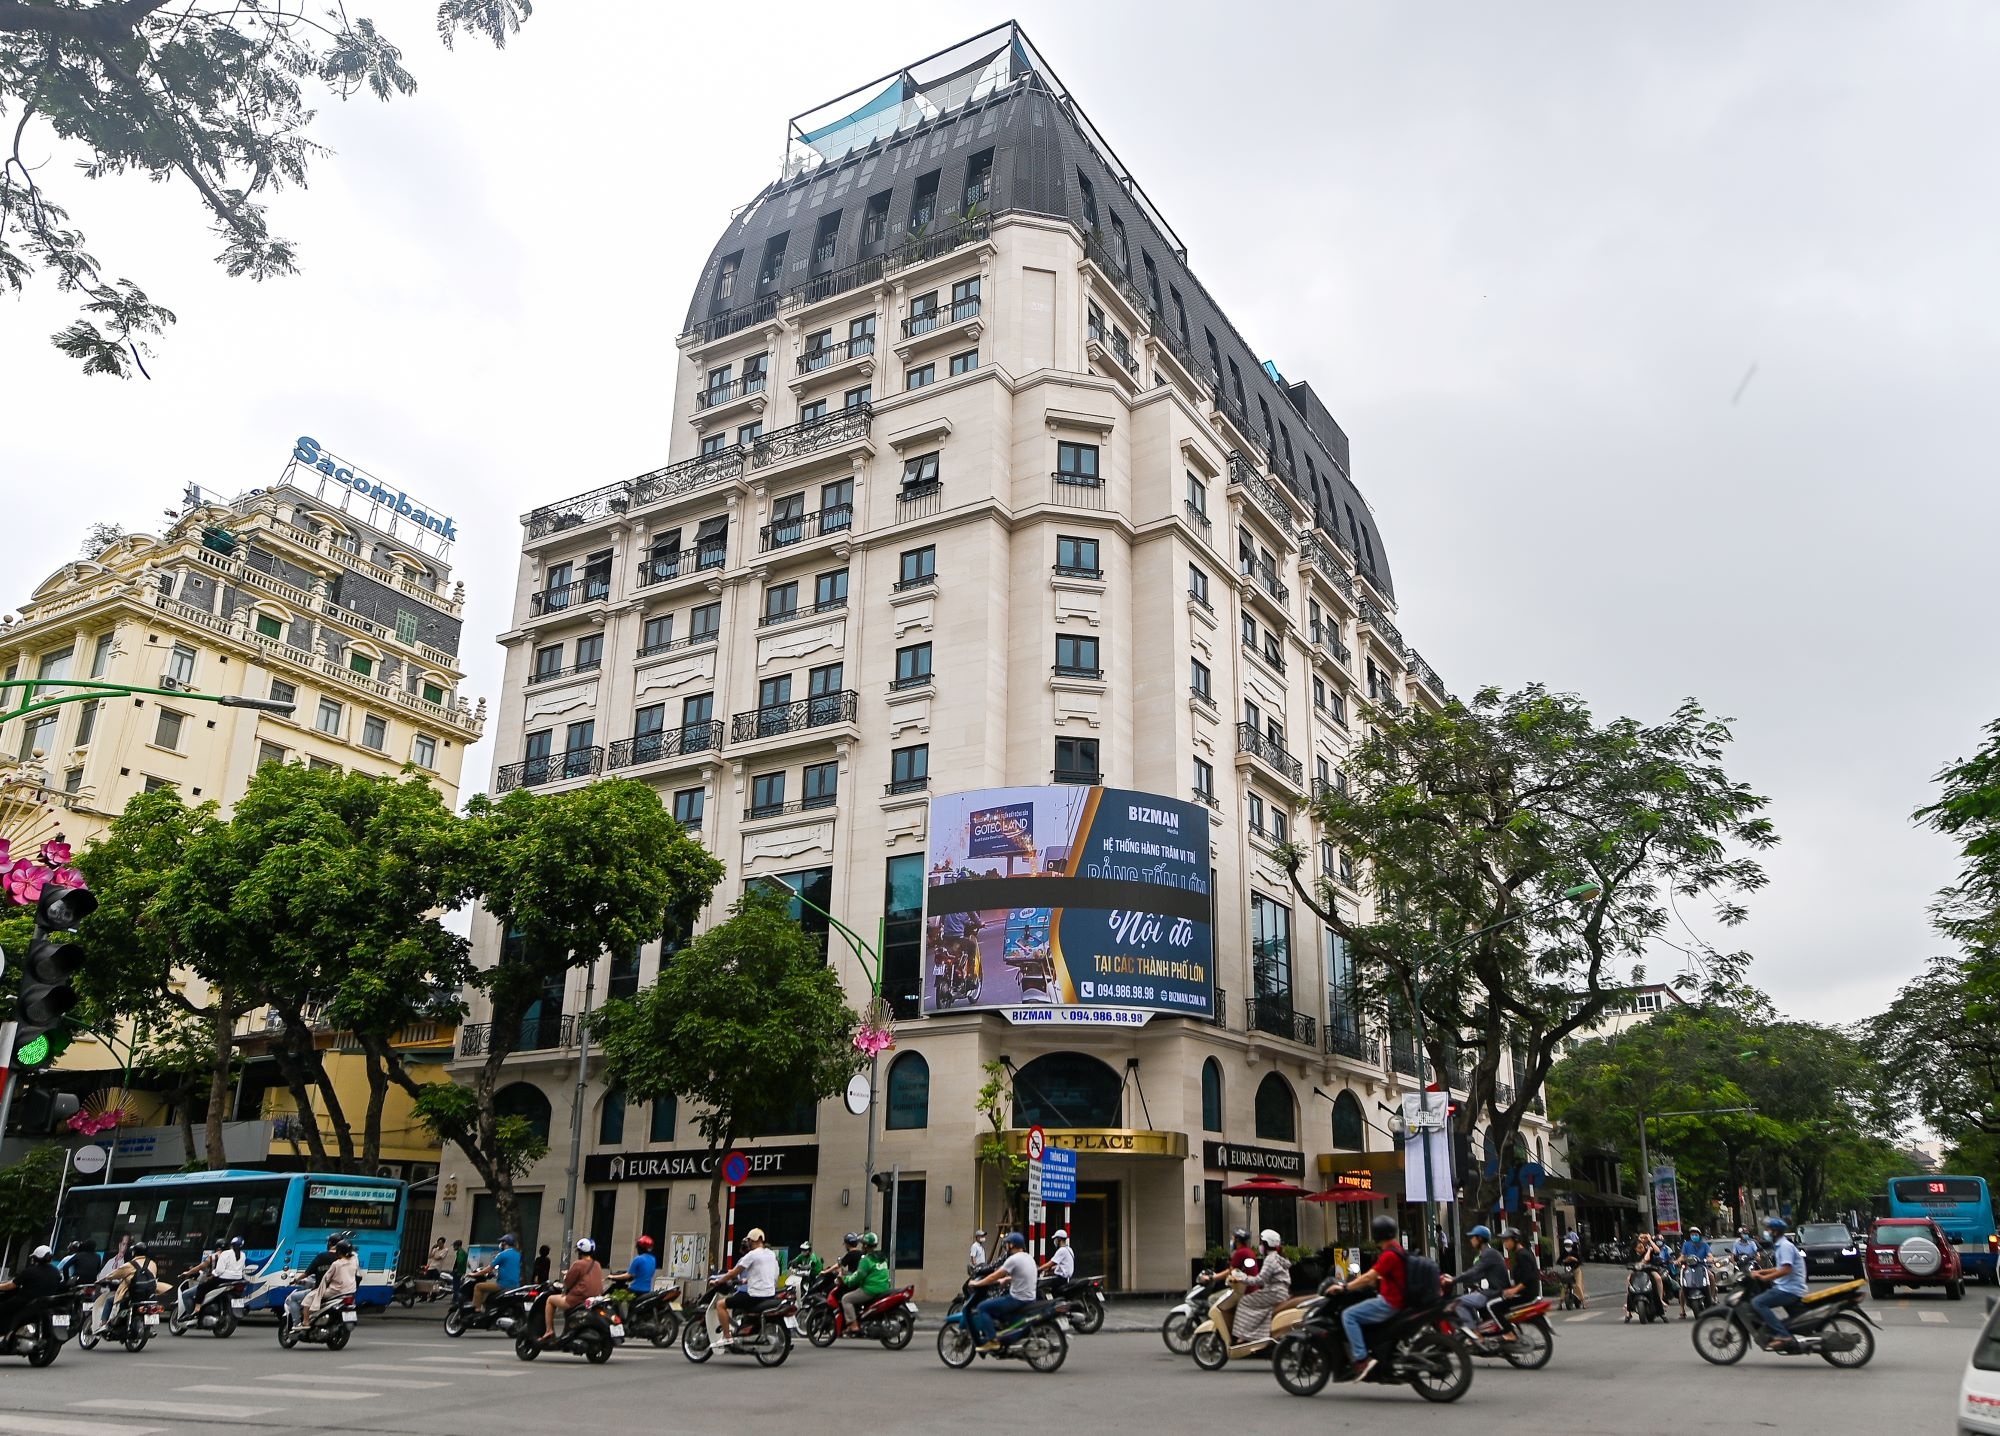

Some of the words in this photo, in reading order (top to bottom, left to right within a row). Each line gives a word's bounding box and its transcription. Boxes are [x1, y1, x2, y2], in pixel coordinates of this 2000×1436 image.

[293, 436, 458, 541] Sacombank
[974, 821, 1001, 836] GOTEC
[1003, 818, 1028, 832] LAND
[1128, 805, 1179, 828] BIZMAN
[1103, 837, 1113, 853] HỆ
[1115, 838, 1140, 854] THỐNG
[1141, 841, 1160, 857] HÀNG
[1180, 849, 1186, 864] VỊ
[1187, 851, 1196, 865] TRÍ
[1108, 909, 1163, 949] Nội
[1168, 916, 1193, 948] đô
[1094, 955, 1111, 976] TẠI
[1114, 953, 1134, 974] CÁC
[1136, 955, 1169, 978] THÀNH
[1171, 959, 1188, 980] PHỐ
[1189, 962, 1204, 983] LỚN
[1097, 983, 1154, 1000] 094.986.98.98
[1012, 1010, 1052, 1021] BIZMAN
[1069, 1010, 1143, 1023] 094.986.98.98
[1073, 1135, 1134, 1149] PLACE
[629, 1157, 697, 1176] EURASIA
[701, 1153, 785, 1173] CEPT
[1231, 1150, 1265, 1167] EURASIA
[1265, 1154, 1299, 1170] CONCEPT
[1929, 1183, 1945, 1193] 31
